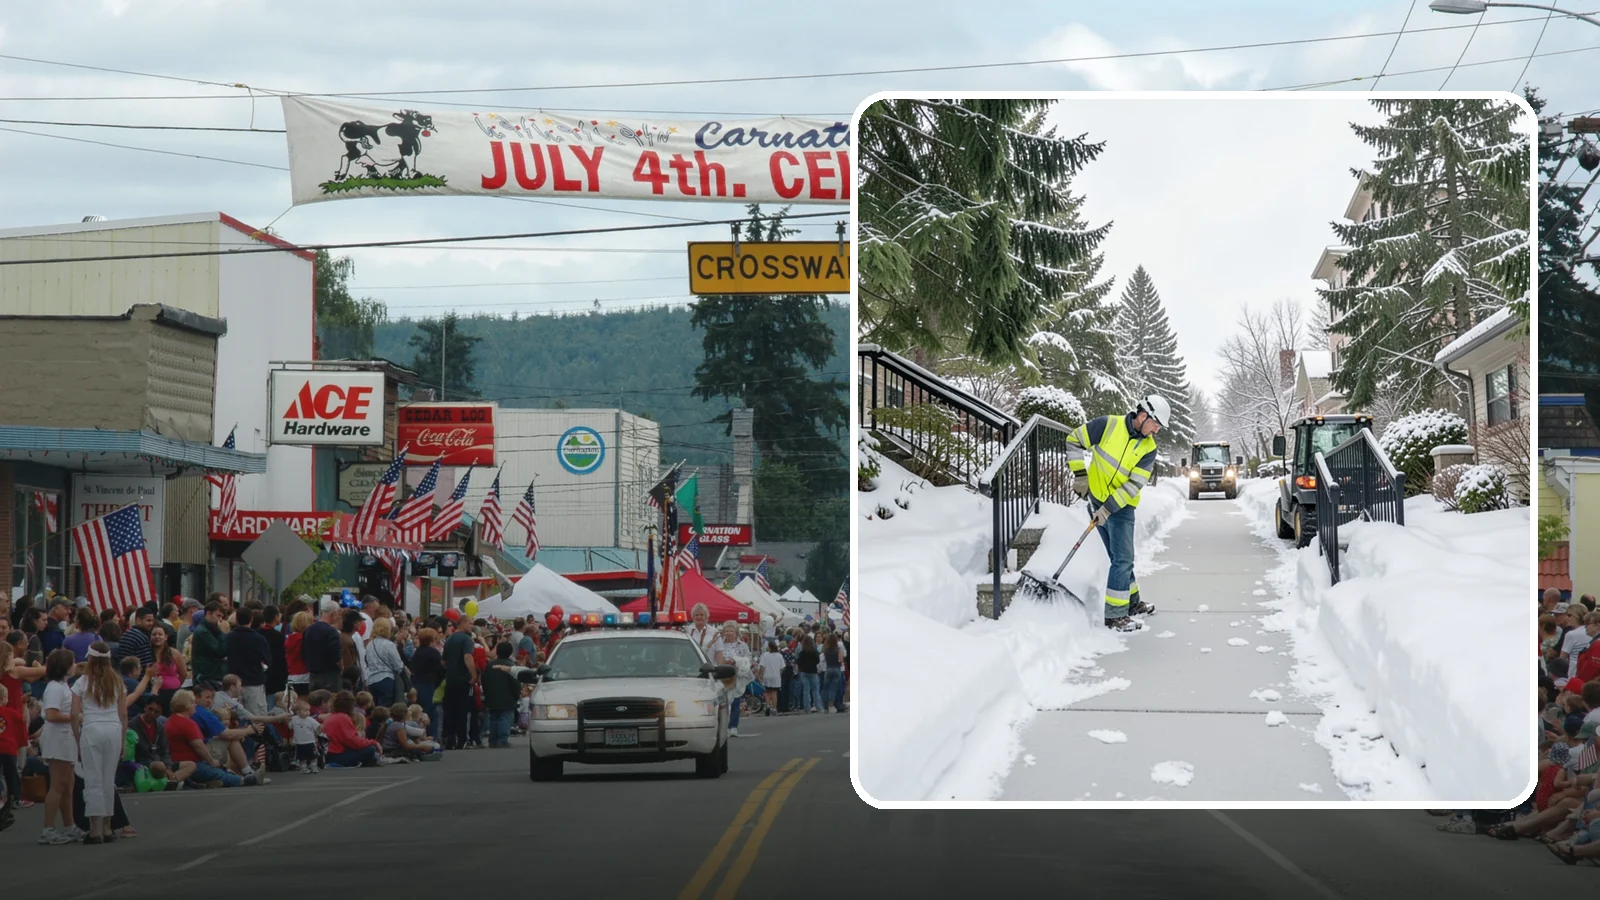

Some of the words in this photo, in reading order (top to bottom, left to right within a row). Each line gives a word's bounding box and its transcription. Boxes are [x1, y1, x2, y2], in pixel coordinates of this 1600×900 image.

[695, 121, 850, 149] Carnat
[481, 142, 604, 192] JULY
[632, 149, 746, 197] 4th.
[697, 254, 850, 280] CROSSWA
[283, 380, 374, 420] ACE
[405, 409, 453, 422] CEDAR
[461, 409, 485, 422] LOG
[283, 421, 371, 437] Hardware
[353, 467, 386, 480] Simpl
[83, 485, 92, 494] St.
[96, 485, 124, 494] Vincent
[126, 486, 136, 494] de
[137, 486, 155, 495] Paul
[80, 503, 154, 521] THT
[212, 516, 330, 536] HARDARE
[688, 526, 742, 535] CRNATION
[699, 535, 731, 543] GLASS
